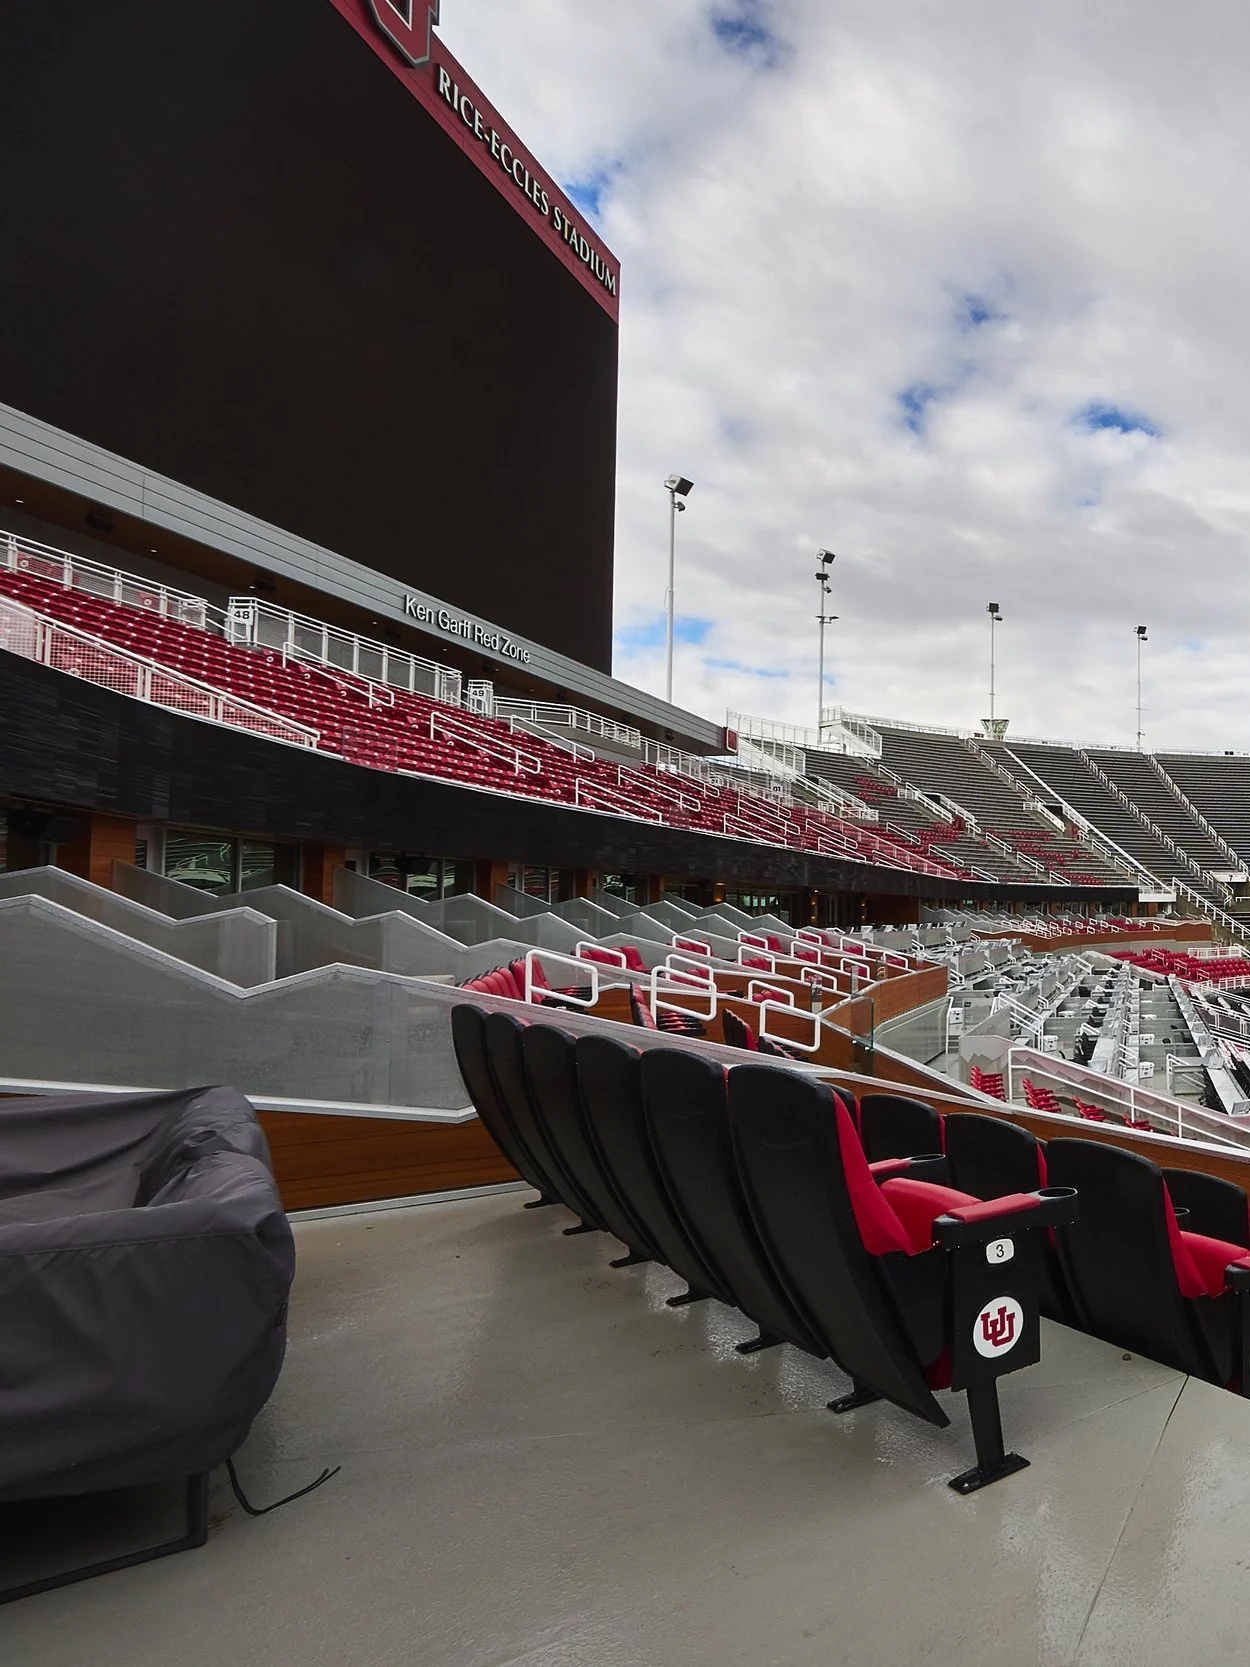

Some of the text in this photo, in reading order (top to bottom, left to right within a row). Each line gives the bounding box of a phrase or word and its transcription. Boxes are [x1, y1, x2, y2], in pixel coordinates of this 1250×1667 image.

[438, 65, 617, 297] RICE-ECCLES STADIUM
[234, 610, 250, 619] 48
[404, 594, 531, 664] Ken Garff Red Zone
[995, 1243, 1005, 1258] 3
